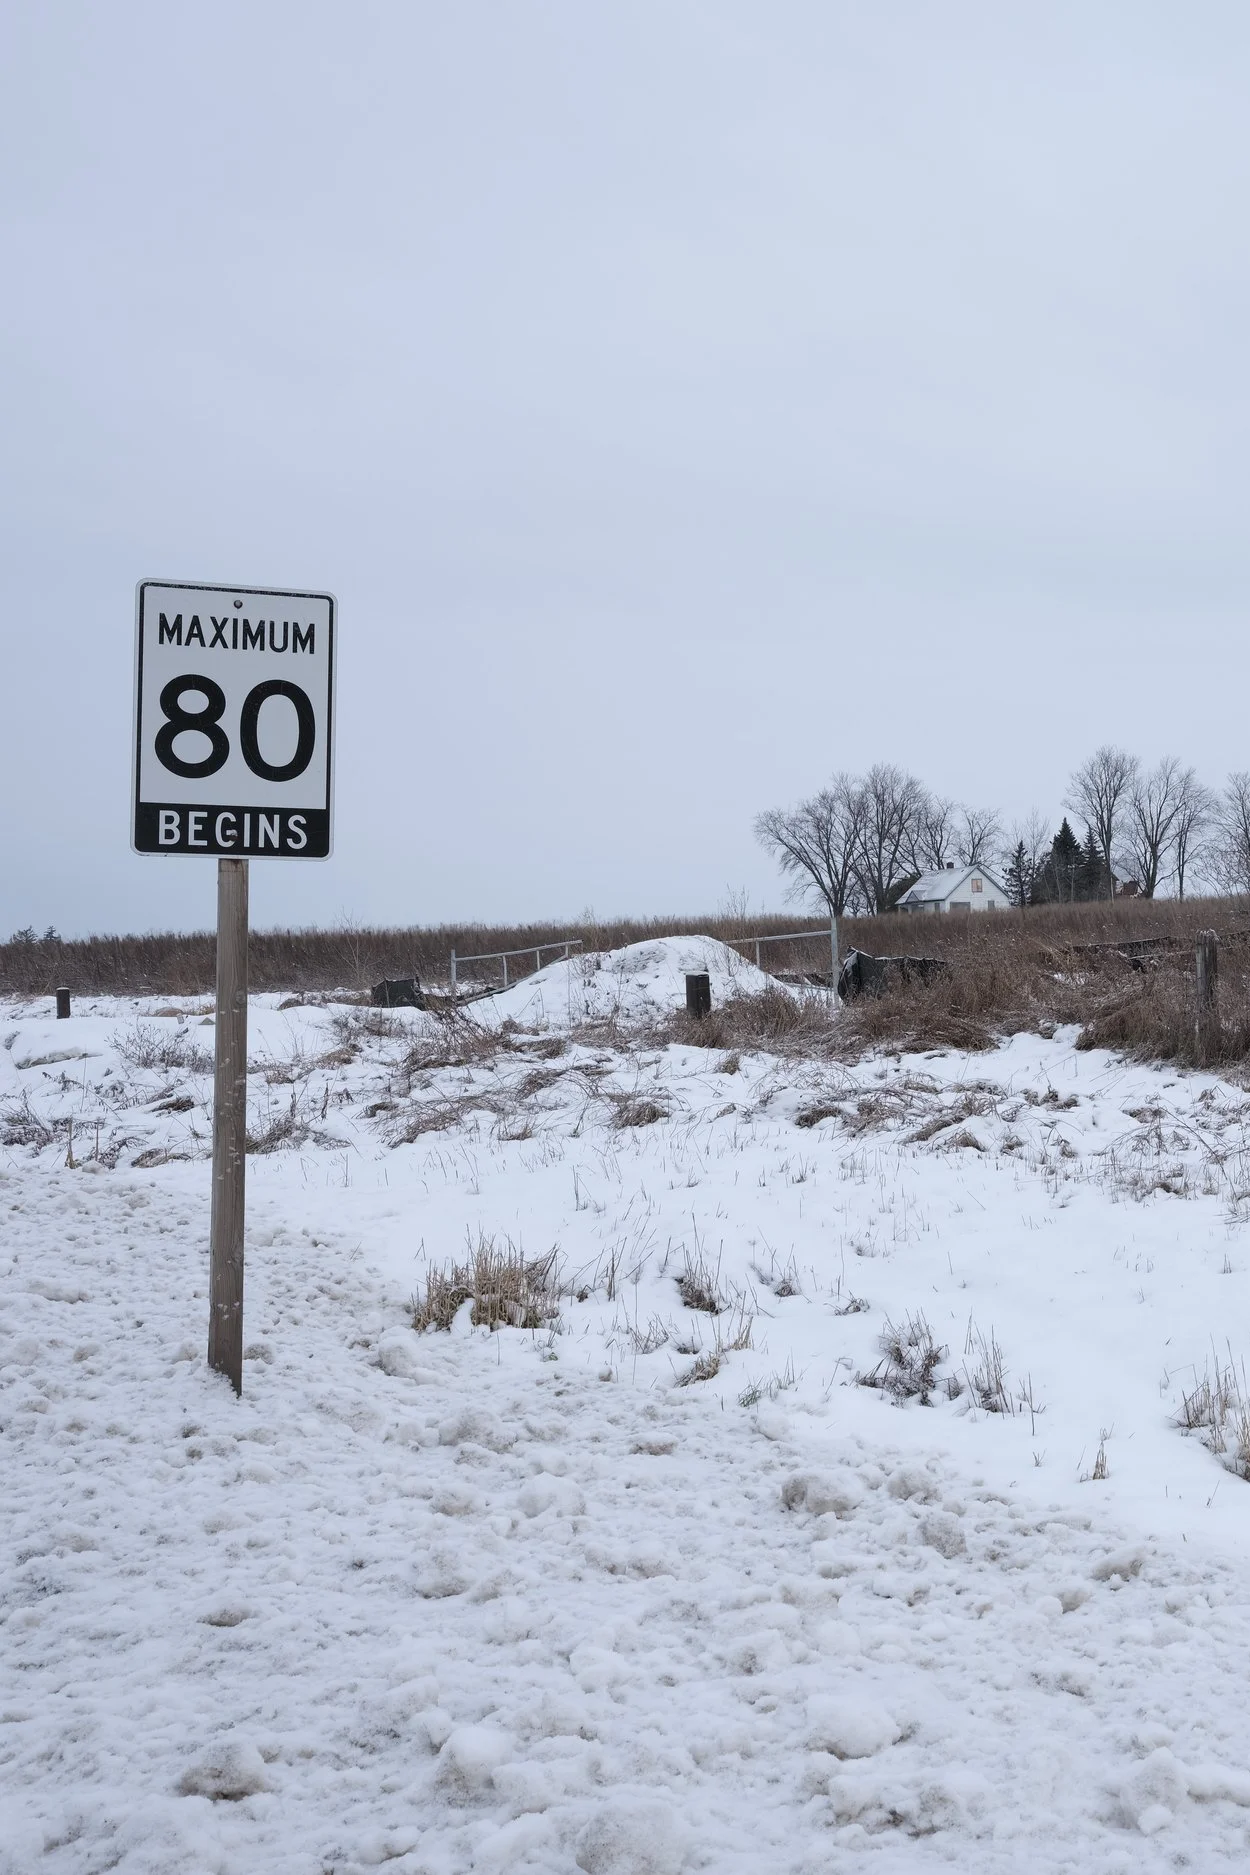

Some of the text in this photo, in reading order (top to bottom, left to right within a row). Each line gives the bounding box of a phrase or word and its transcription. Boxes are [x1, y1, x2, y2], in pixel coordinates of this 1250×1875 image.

[158, 612, 316, 655] MAXIMUM
[154, 673, 316, 783] 80
[158, 809, 308, 850] BEGINS
